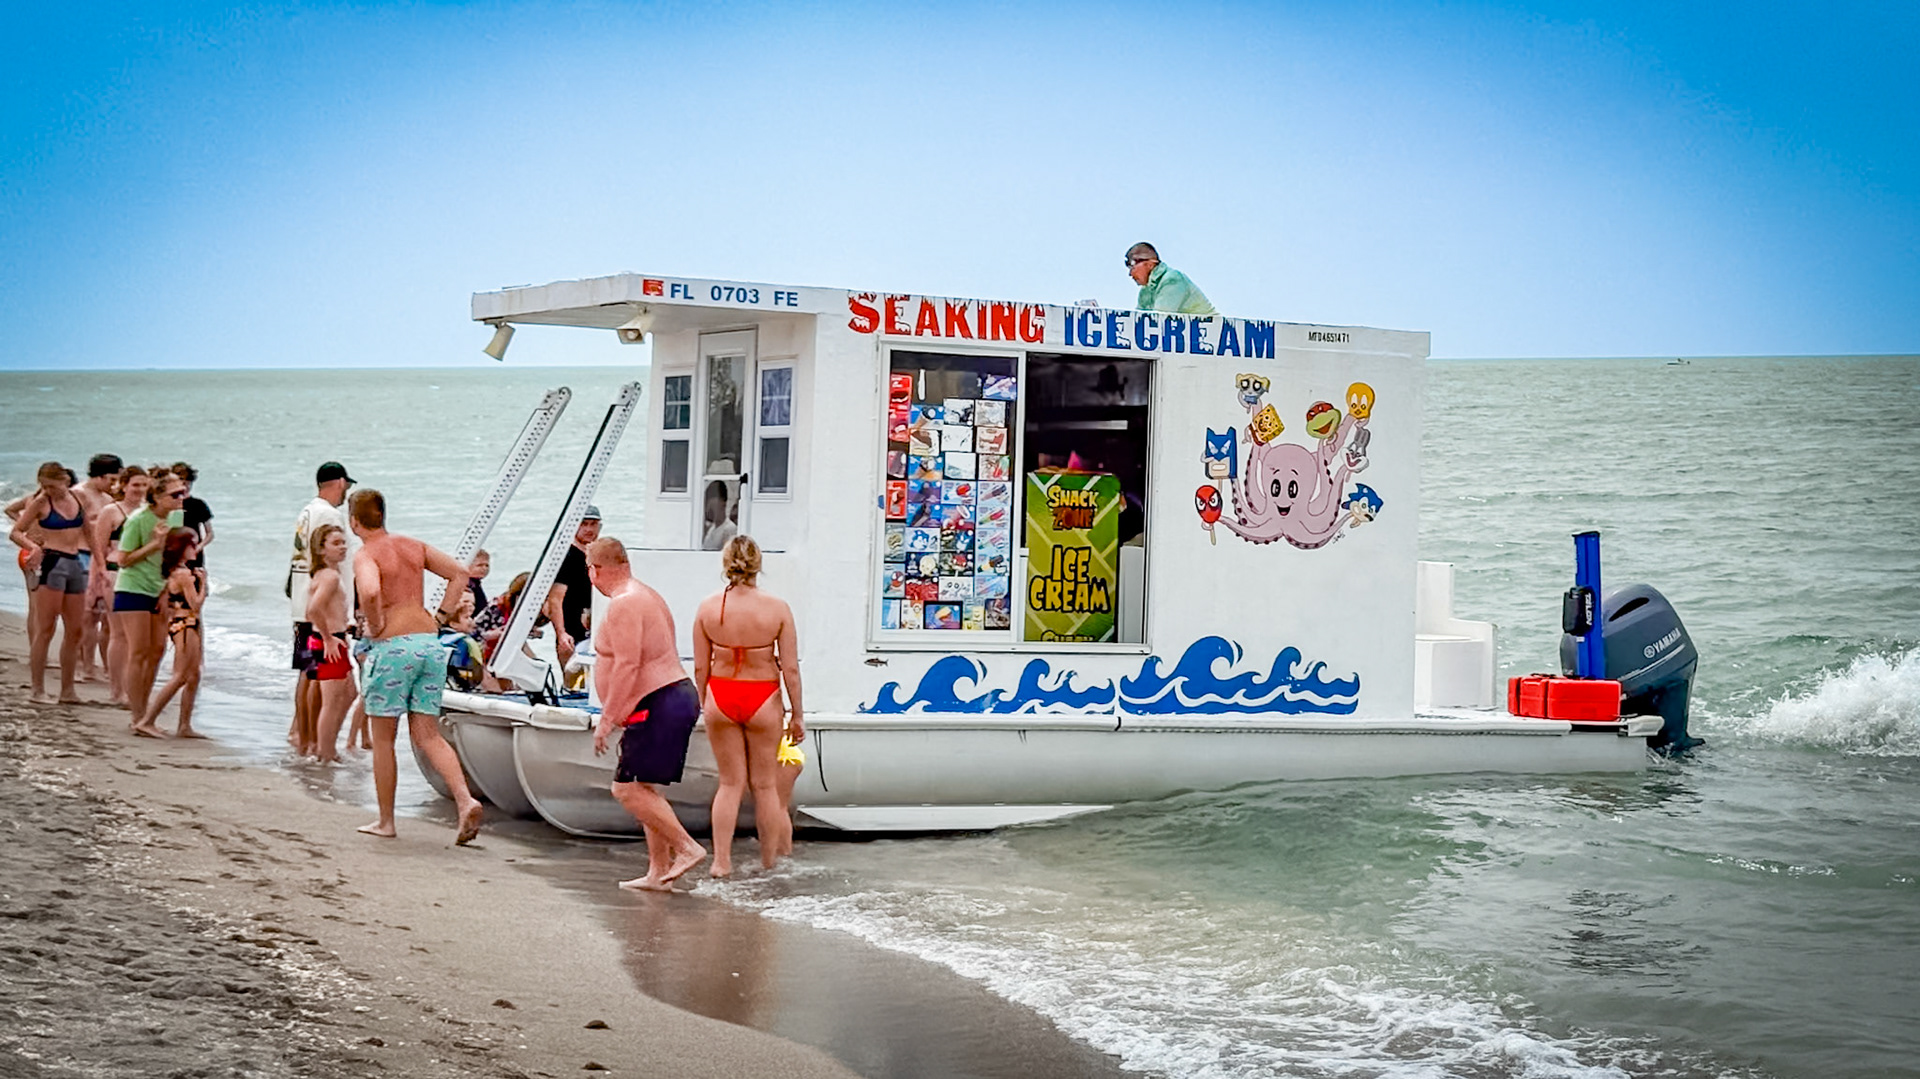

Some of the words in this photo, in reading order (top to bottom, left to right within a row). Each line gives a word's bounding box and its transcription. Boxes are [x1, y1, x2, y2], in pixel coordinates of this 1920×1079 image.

[670, 282, 695, 300] FL
[710, 285, 760, 304] 0703
[774, 290, 799, 307] FE
[848, 292, 1046, 344] SEAKING
[1047, 484, 1099, 508] SNACK
[1052, 507, 1094, 530] ZONE
[1052, 545, 1091, 583] ICE
[1029, 576, 1111, 613] CREAM
[1653, 627, 1681, 653] YAMAHA
